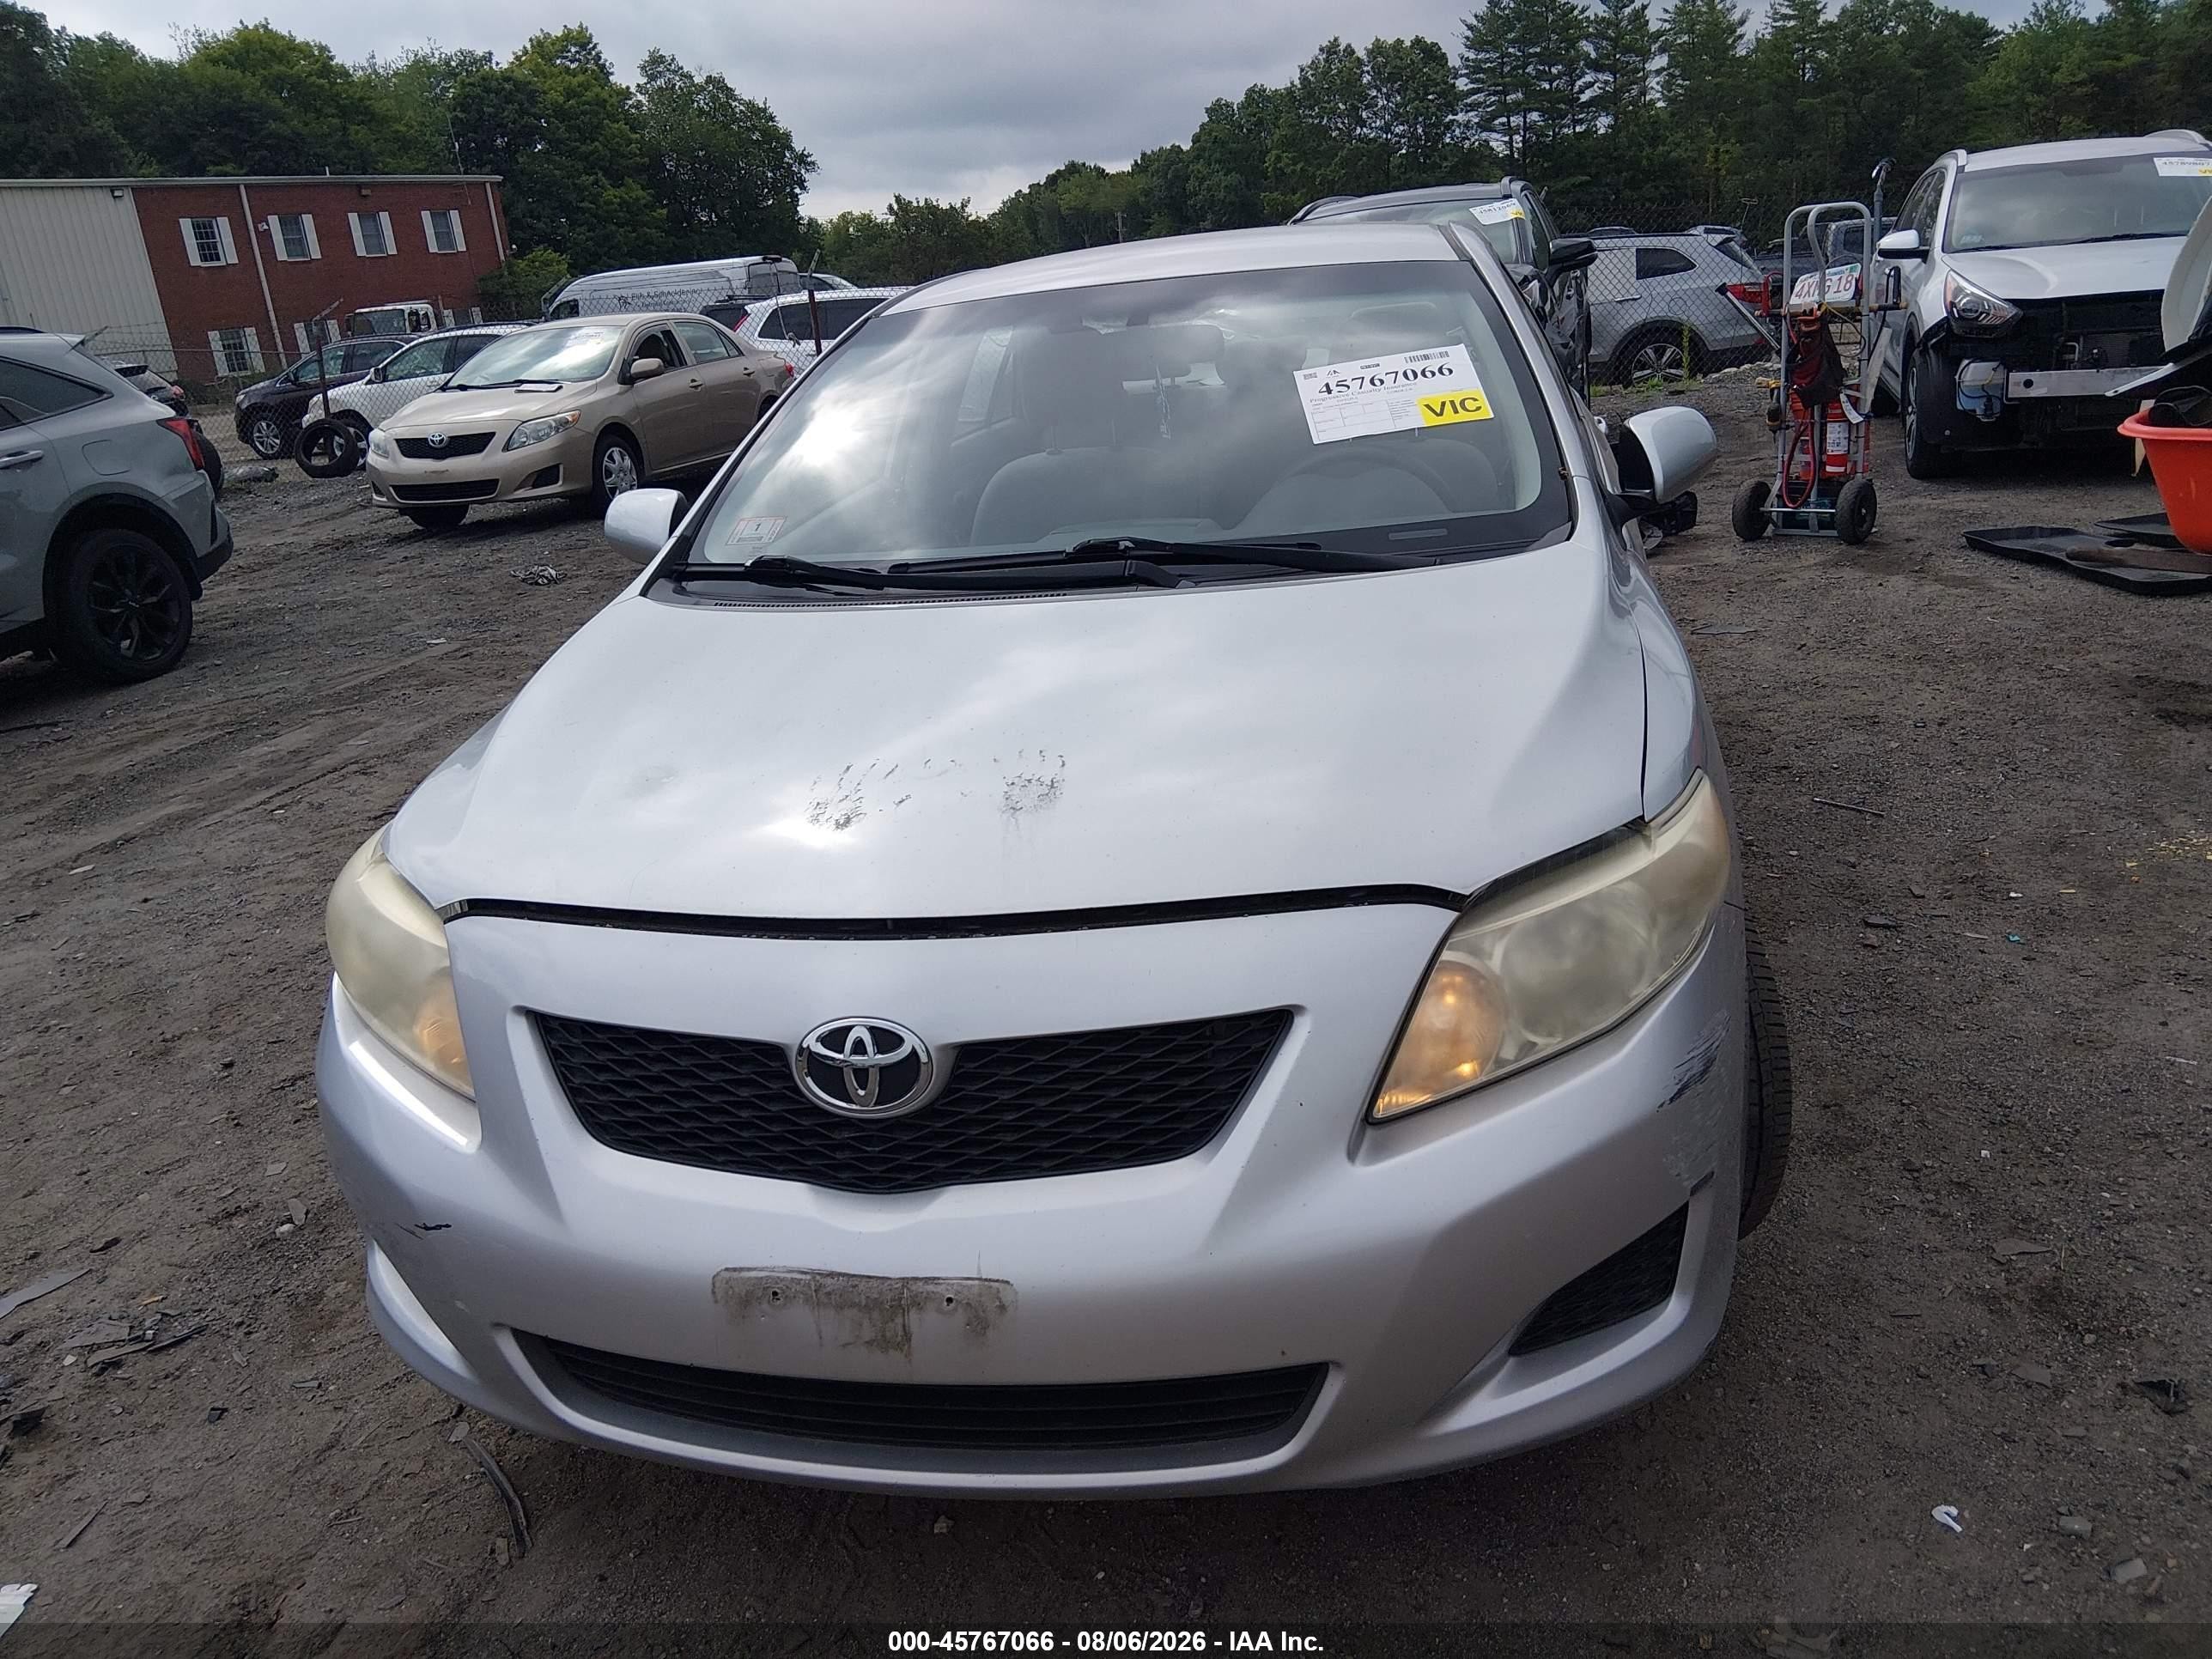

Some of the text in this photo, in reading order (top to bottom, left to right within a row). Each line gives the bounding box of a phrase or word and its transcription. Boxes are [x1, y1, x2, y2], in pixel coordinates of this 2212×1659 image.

[1833, 274, 1854, 294] 18
[1318, 362, 1454, 396] 45767066
[1423, 396, 1483, 418] VIC
